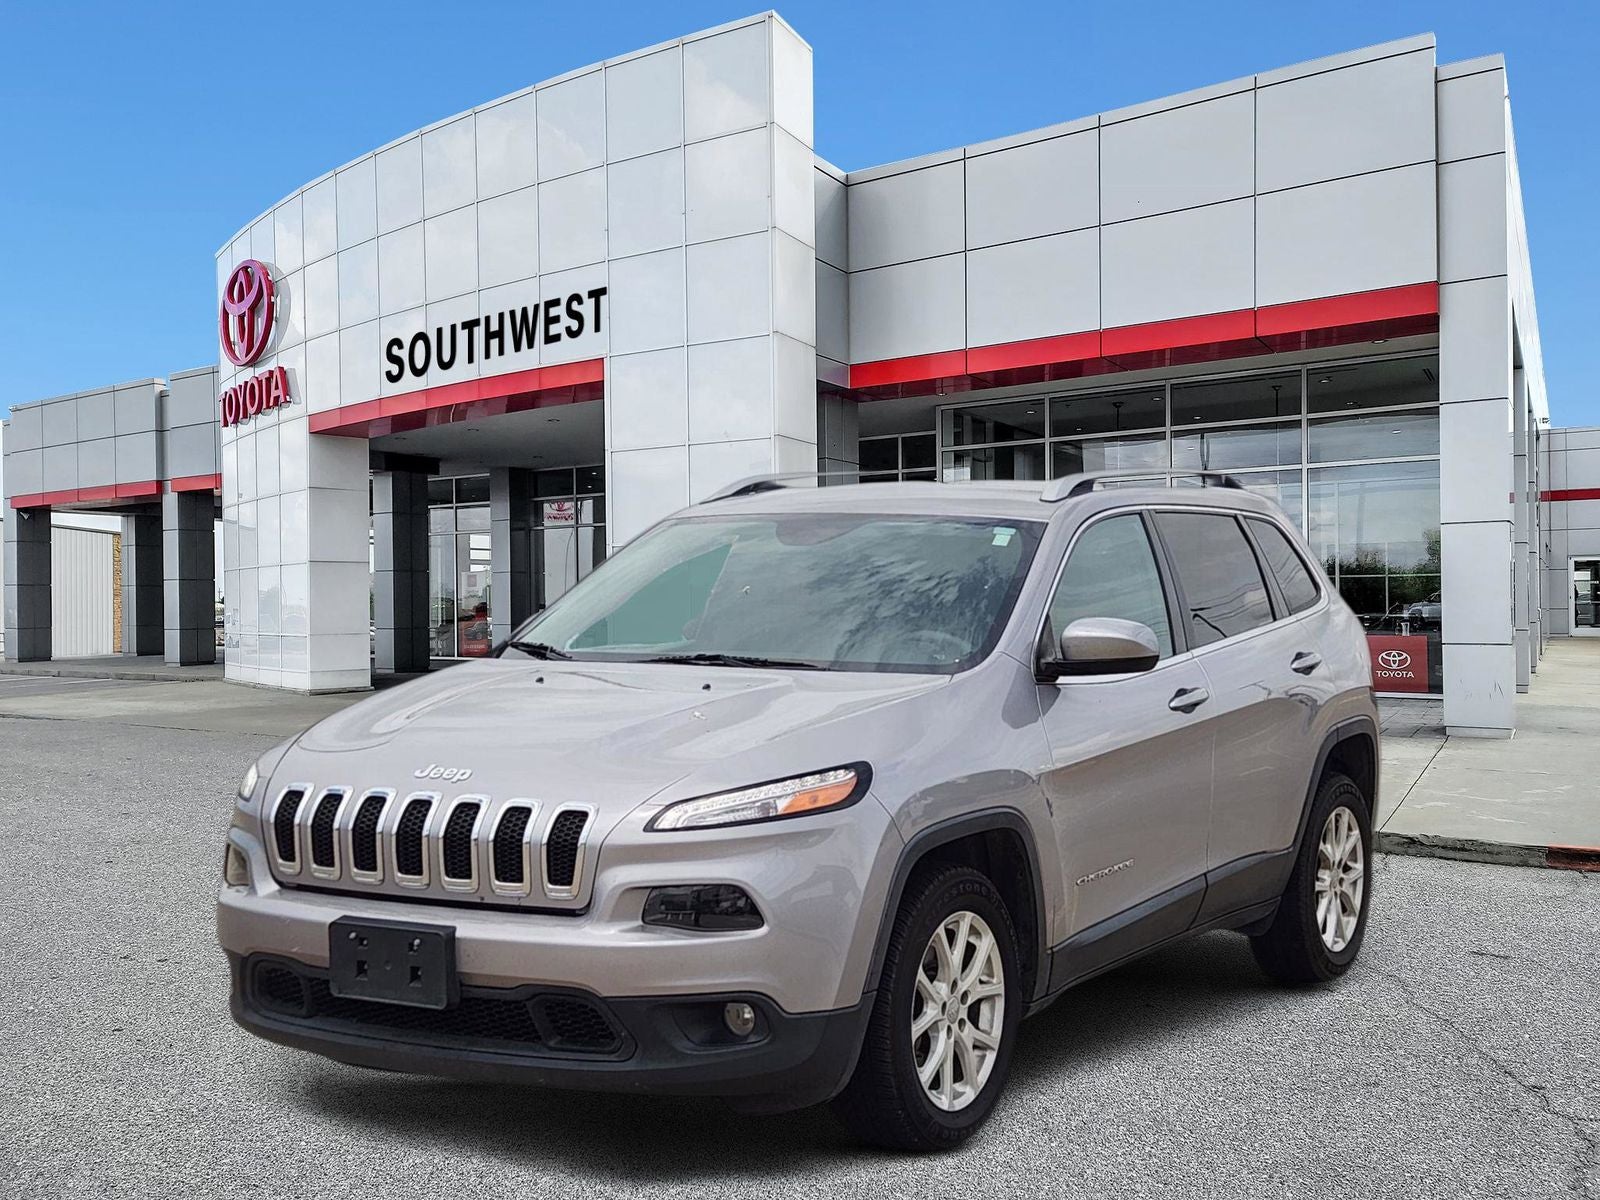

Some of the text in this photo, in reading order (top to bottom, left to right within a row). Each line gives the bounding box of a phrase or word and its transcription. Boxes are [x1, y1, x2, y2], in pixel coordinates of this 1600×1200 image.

[385, 286, 607, 383] SOUTHWEST
[219, 366, 291, 427] TOYOTA
[1376, 670, 1415, 678] TOYOTA
[414, 764, 472, 783] Jeep
[1076, 858, 1135, 886] CHEROKEE
